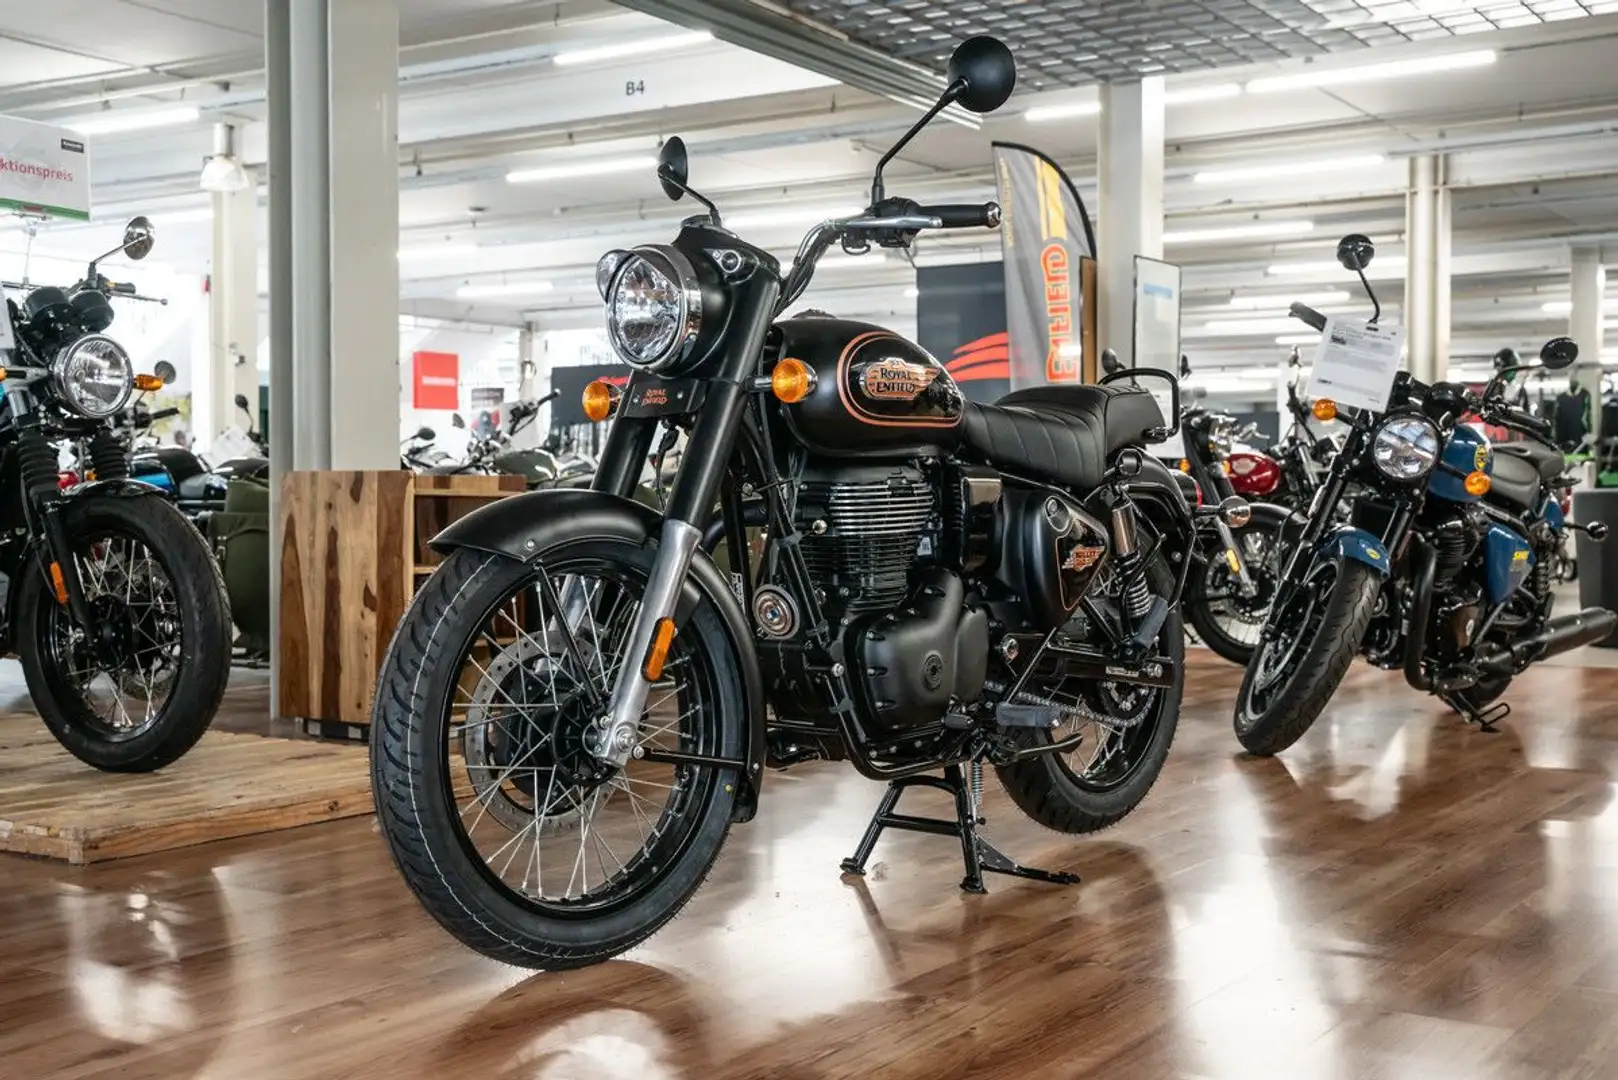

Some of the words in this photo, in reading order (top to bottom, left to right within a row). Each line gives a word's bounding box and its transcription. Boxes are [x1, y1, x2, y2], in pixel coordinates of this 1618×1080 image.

[626, 80, 644, 96] B4
[0, 157, 74, 182] ktionspreis
[880, 368, 911, 380] ROYAL
[876, 381, 915, 393] ENFIELD
